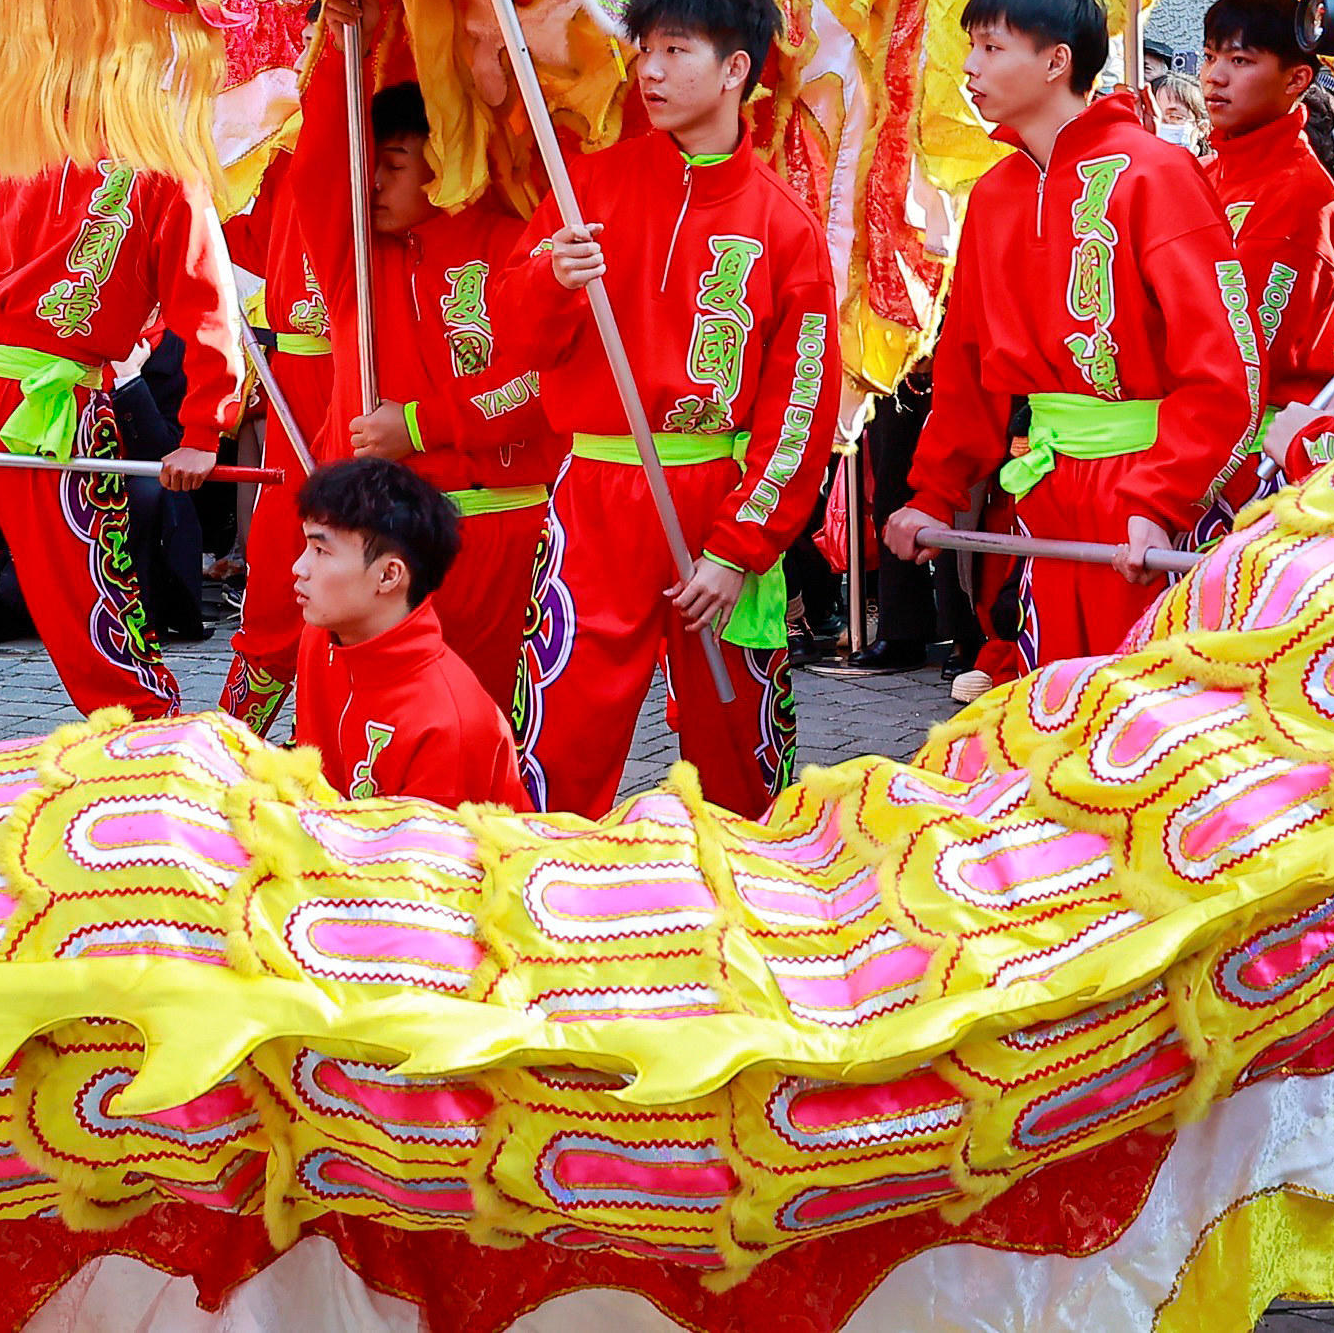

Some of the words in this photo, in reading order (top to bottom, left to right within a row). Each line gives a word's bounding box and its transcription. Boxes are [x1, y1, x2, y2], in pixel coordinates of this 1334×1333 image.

[36, 159, 136, 339] 夏國璋
[1215, 259, 1261, 366] MOON
[470, 377, 528, 420] YAU
[736, 480, 780, 526] YAU
[764, 406, 813, 487] KUNG
[790, 313, 827, 410] MOON
